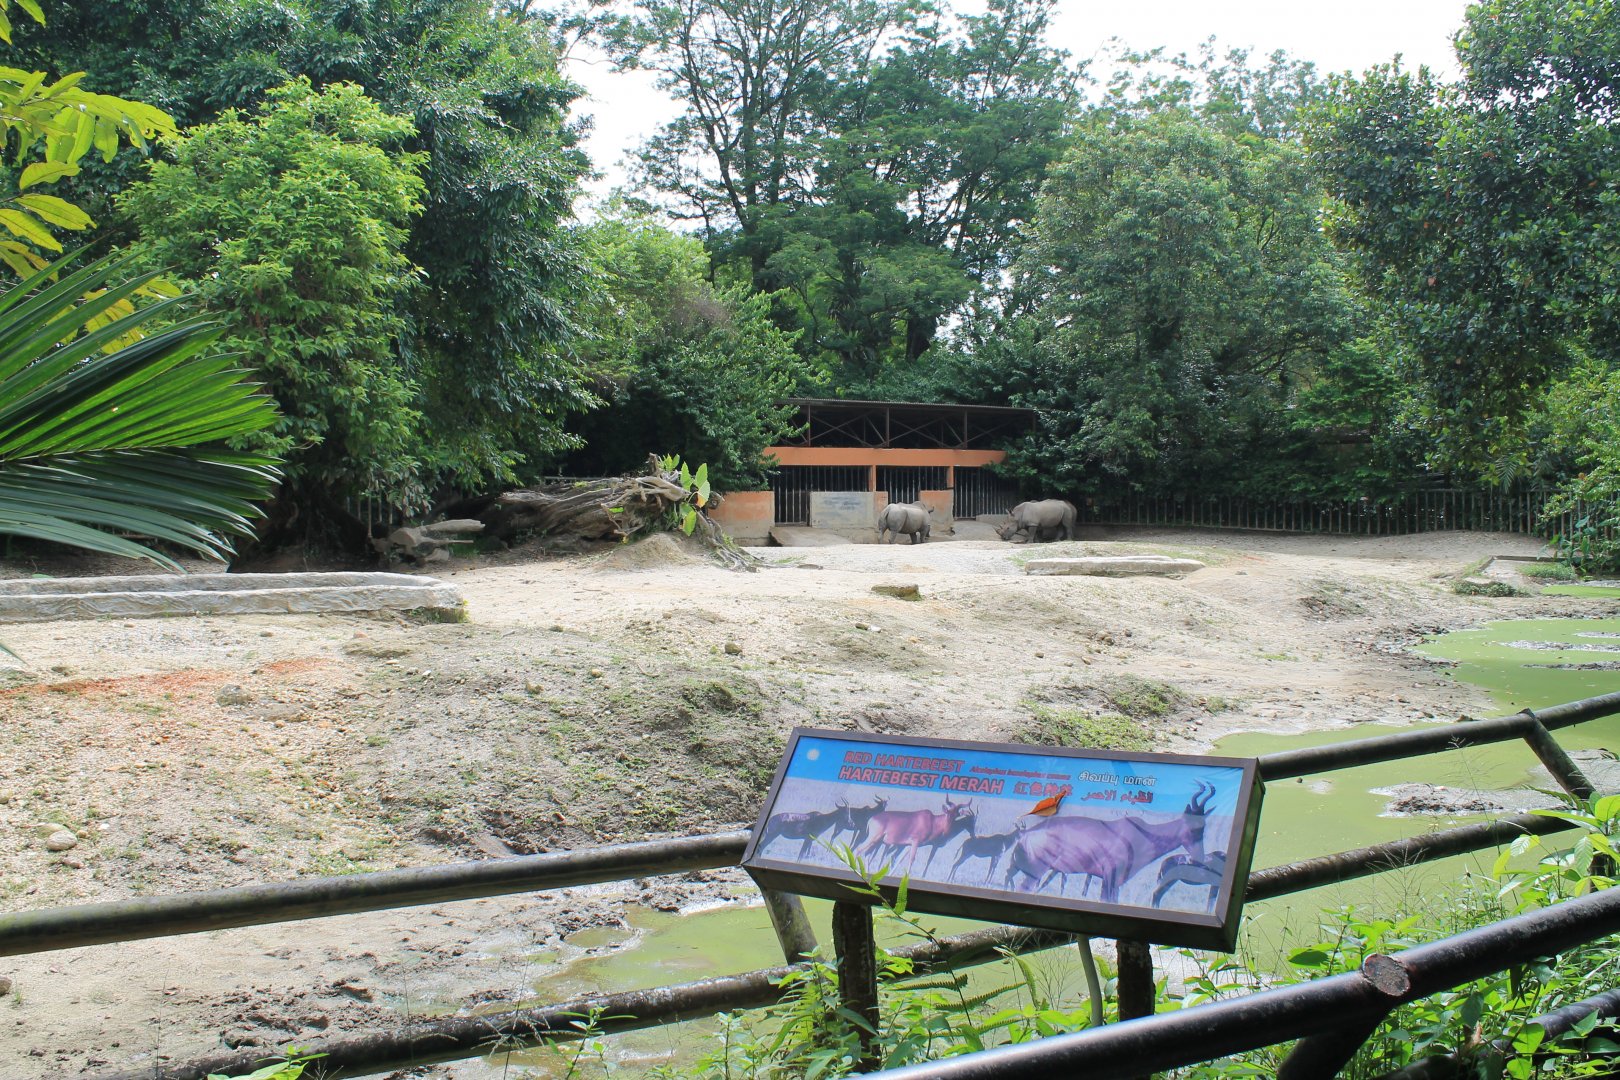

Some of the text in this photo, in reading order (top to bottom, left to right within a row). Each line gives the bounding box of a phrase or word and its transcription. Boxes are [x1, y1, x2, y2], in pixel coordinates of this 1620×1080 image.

[844, 751, 872, 764] RED
[874, 753, 965, 773] HARTEBEEST
[838, 765, 1005, 795] HARTEBEEST MERAH
[1078, 770, 1119, 786] சிவப்பு
[1123, 775, 1157, 787] மான்
